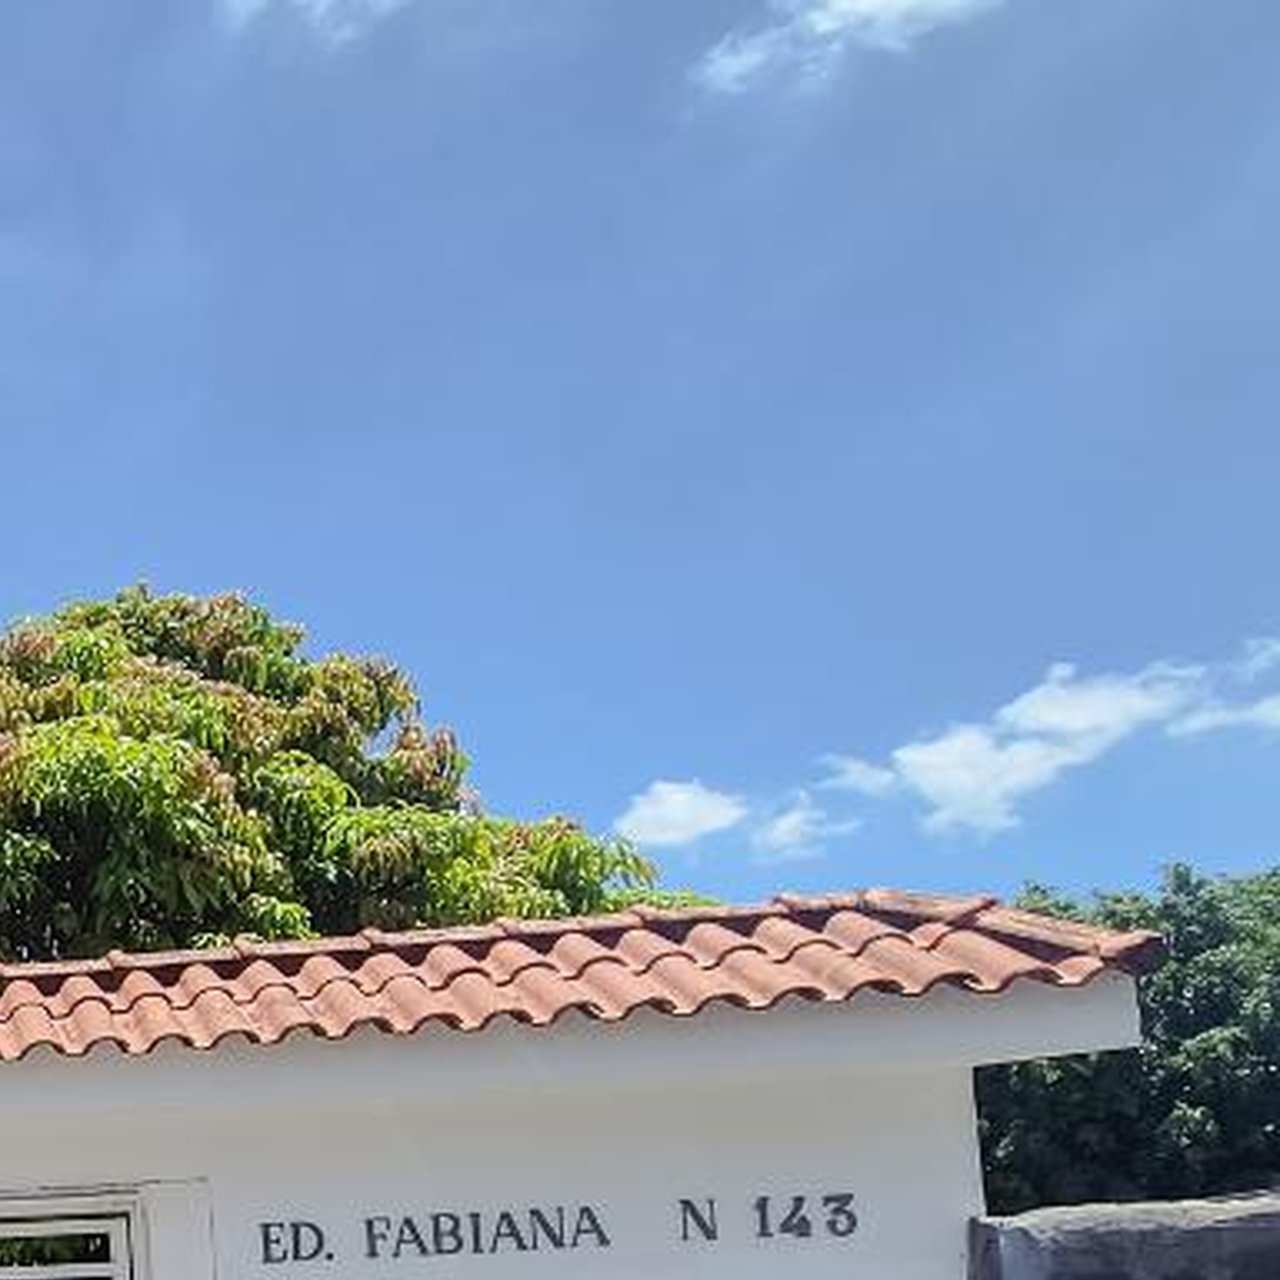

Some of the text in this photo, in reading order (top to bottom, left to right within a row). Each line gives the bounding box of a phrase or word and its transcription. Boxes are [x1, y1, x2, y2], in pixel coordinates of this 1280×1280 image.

[260, 1193, 858, 1264] ED. FABIANA N 143
